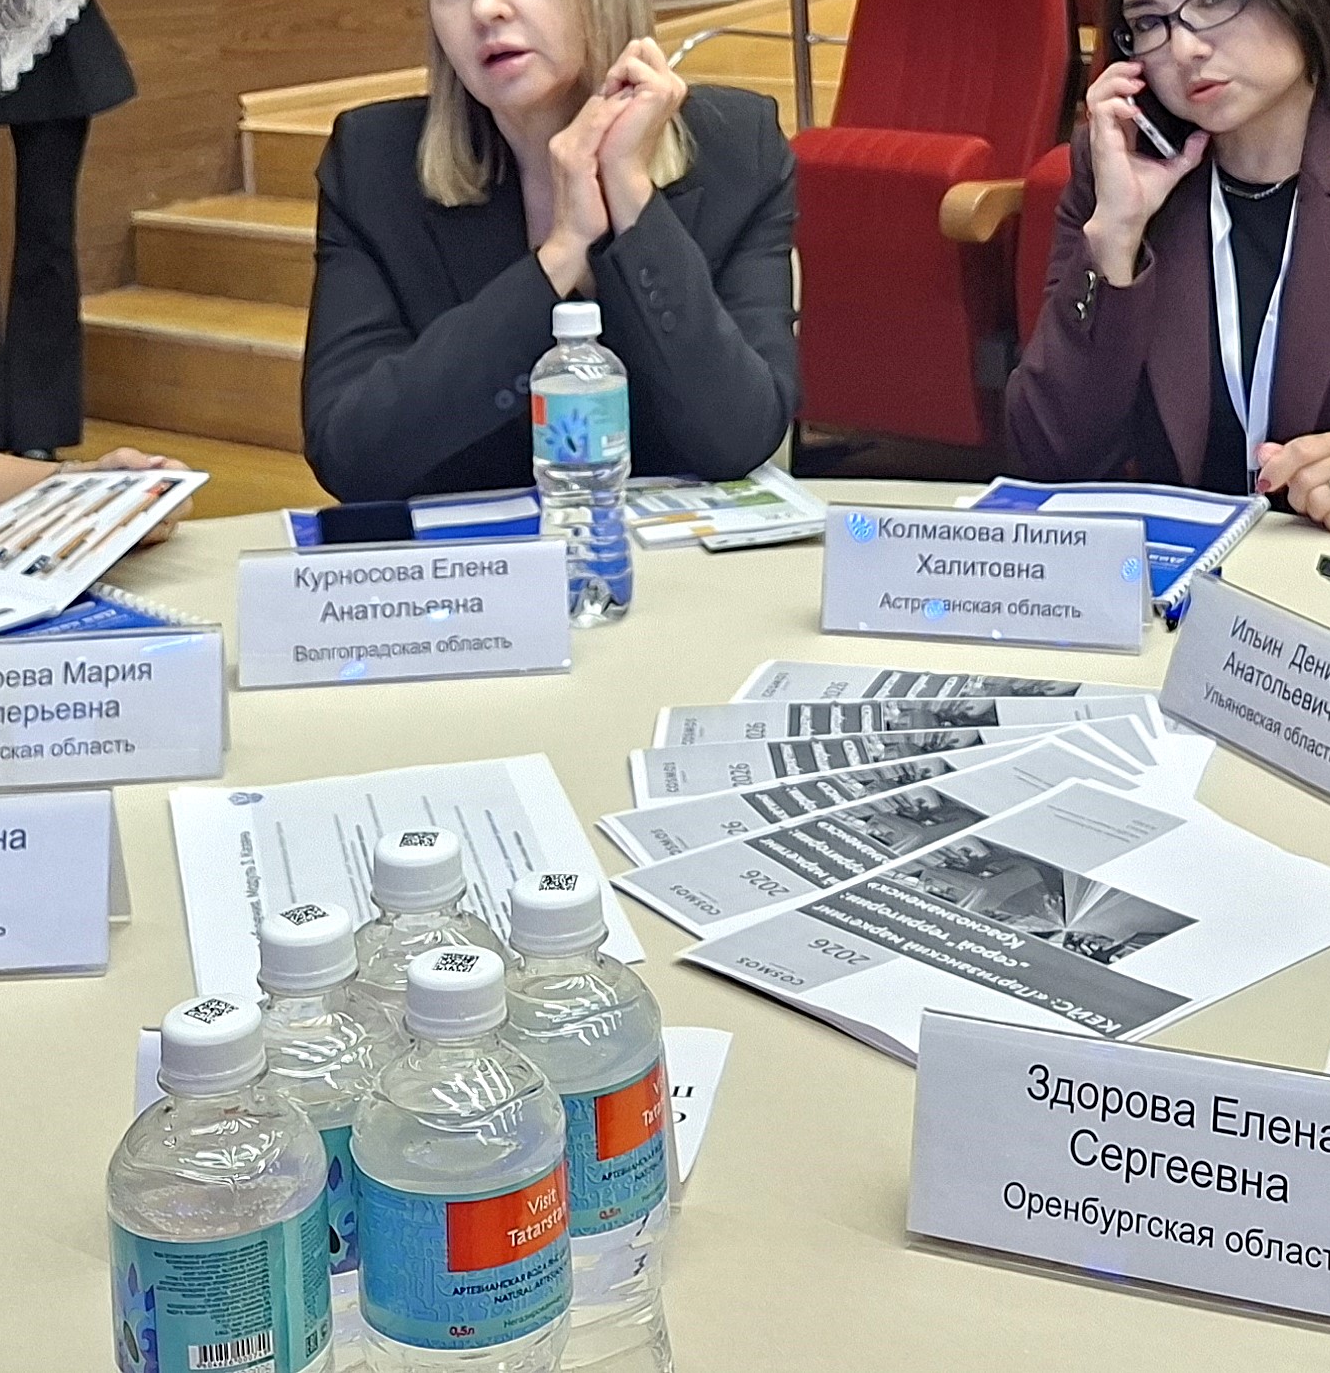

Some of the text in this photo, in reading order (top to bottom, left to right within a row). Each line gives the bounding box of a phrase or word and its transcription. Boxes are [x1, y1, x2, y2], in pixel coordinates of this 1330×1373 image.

[878, 516, 1087, 546] Колмакова Лилия
[294, 557, 509, 592] Курносова Елена
[916, 553, 1045, 579] Халитовна
[320, 595, 484, 623] Анатольевна
[879, 592, 1082, 618] Астраанская область
[294, 635, 513, 663] Волгоградская область
[1229, 615, 1285, 658] Ильин
[63, 659, 153, 687] Мария
[1203, 682, 1282, 736] Ульяновская
[745, 721, 766, 739] 026
[51, 737, 136, 757] область
[721, 820, 750, 836] 26
[739, 869, 790, 896] 2026
[669, 884, 722, 916] COSMOS
[811, 904, 905, 944] маркетинг
[807, 938, 871, 965] 2026
[736, 956, 806, 988] COSMOS
[1049, 998, 1122, 1033] КЕЙС:
[1026, 1063, 1197, 1129] Здорова
[1069, 1128, 1291, 1204] Сергеевна
[527, 1187, 558, 1217] Visit
[1002, 1180, 1215, 1249] Оренбургская
[506, 1201, 567, 1248] Tatarsta
[493, 1285, 533, 1305] NATURAL
[449, 1325, 475, 1338] 0,5л
